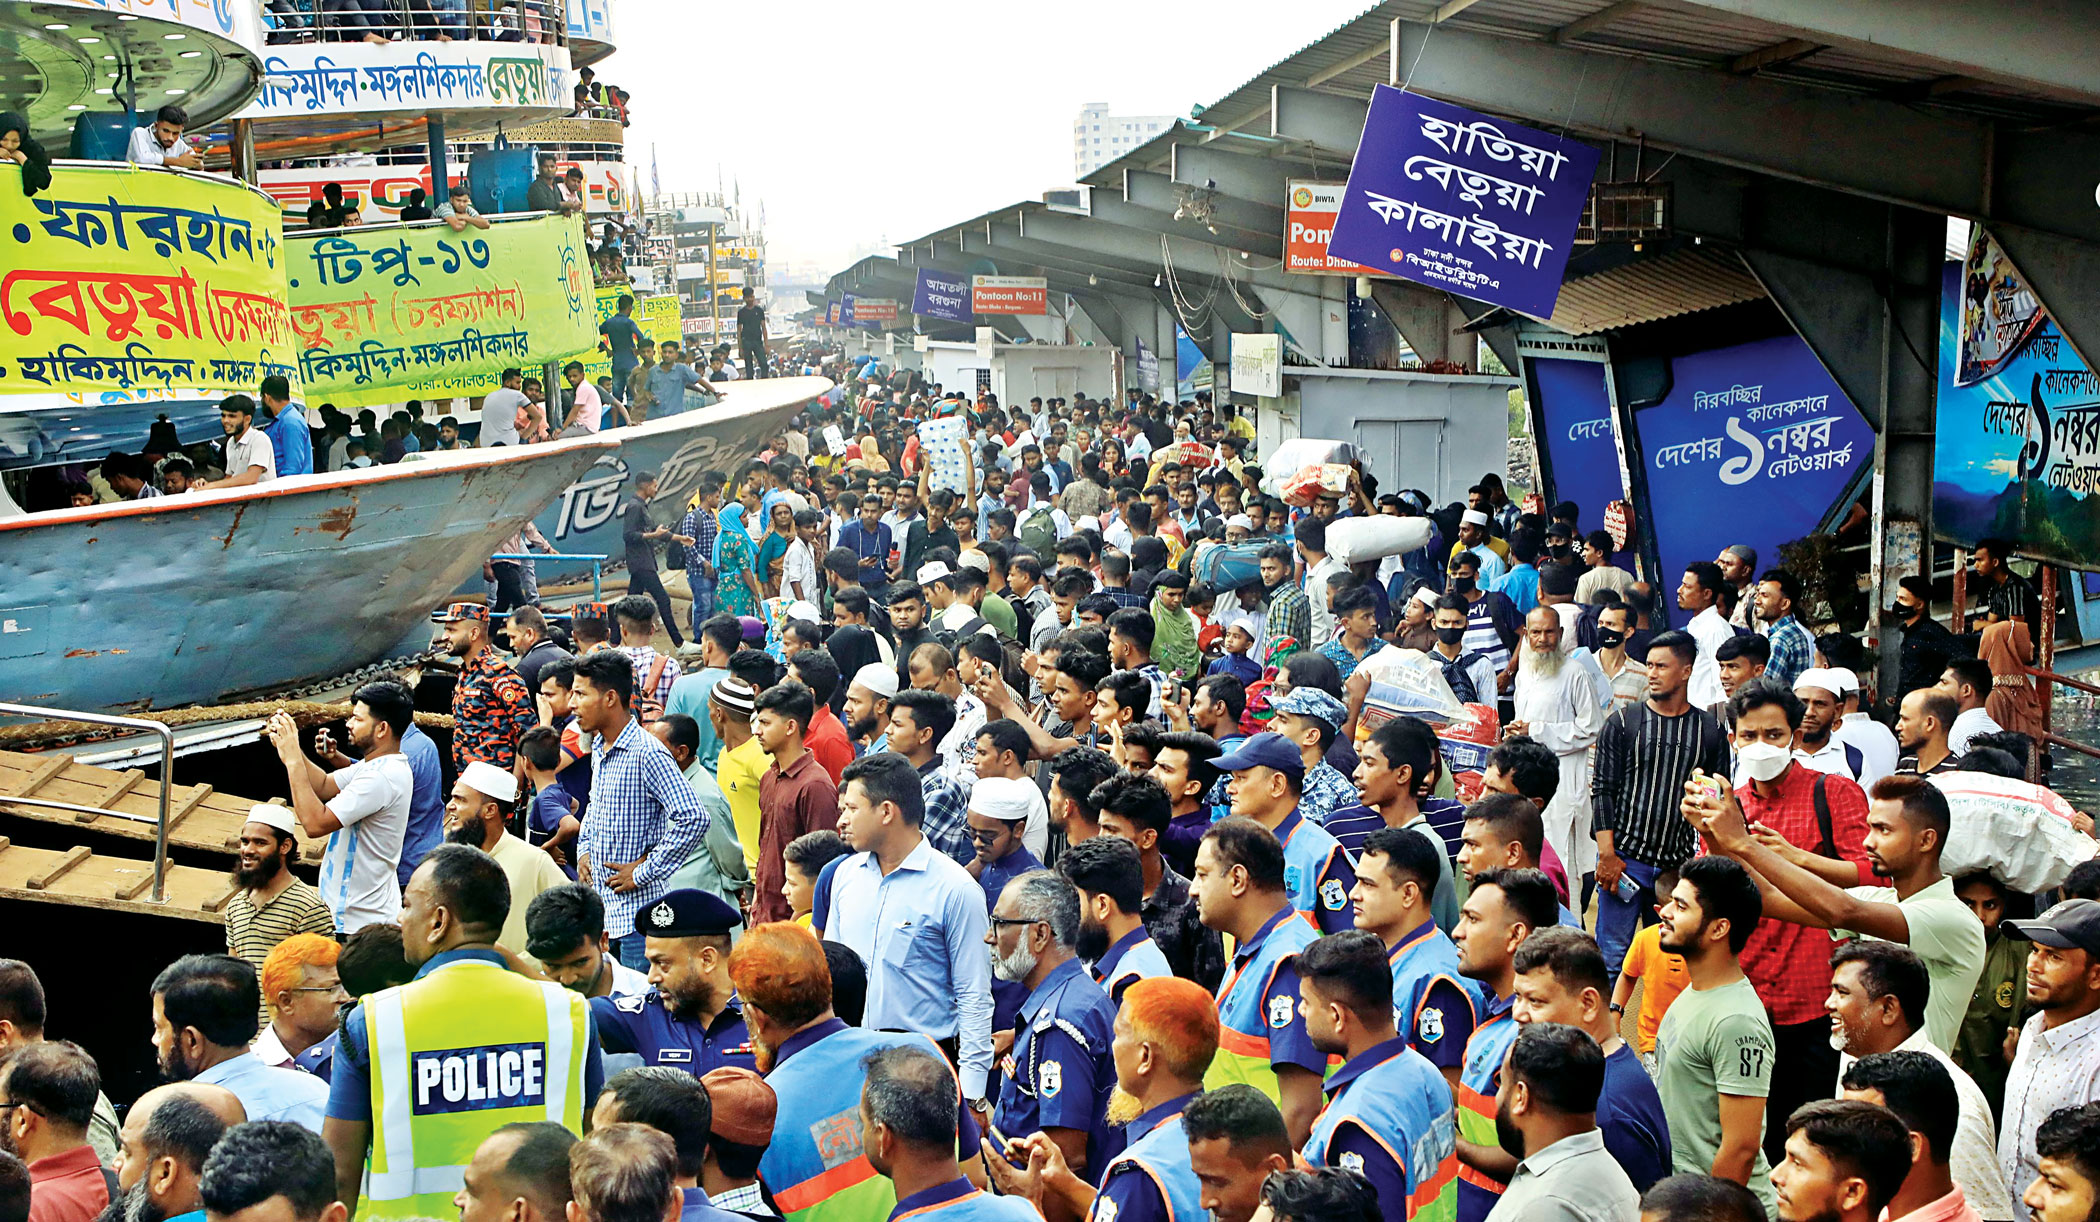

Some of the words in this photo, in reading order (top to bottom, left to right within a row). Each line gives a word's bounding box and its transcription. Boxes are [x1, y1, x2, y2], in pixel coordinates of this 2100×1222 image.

[1418, 112, 1570, 182] হাতিয়া
[1315, 195, 1336, 203] BIWTA
[1404, 155, 1545, 216] বেতুয়া
[1364, 190, 1553, 270] কালাইয়া
[310, 237, 490, 287] টিপু-১৩
[1290, 254, 1324, 268] Route:
[1, 266, 198, 341] বেতুয়া
[926, 279, 967, 297] আমতলী
[928, 293, 962, 309] বরগুনা
[976, 290, 1013, 300] Pontoon
[1015, 291, 1042, 301] No:11
[17, 342, 195, 388] হাকিমুদ্দিন
[1694, 384, 1762, 412] নিরবচ্ছিন্ন
[1746, 394, 1829, 424] কানেকশনে
[1568, 417, 1613, 442] দেশে
[1984, 399, 2028, 437] দেশের
[2017, 372, 2051, 480] ১
[1655, 436, 1723, 469] দেশের
[1719, 417, 1764, 485] ১
[1765, 416, 1842, 455] নম্বর
[1768, 441, 1852, 479] নেটওয়ার্ক
[418, 1049, 542, 1105] POLICE
[1740, 1048, 1764, 1078] 87
[819, 1116, 860, 1158] নৌ
